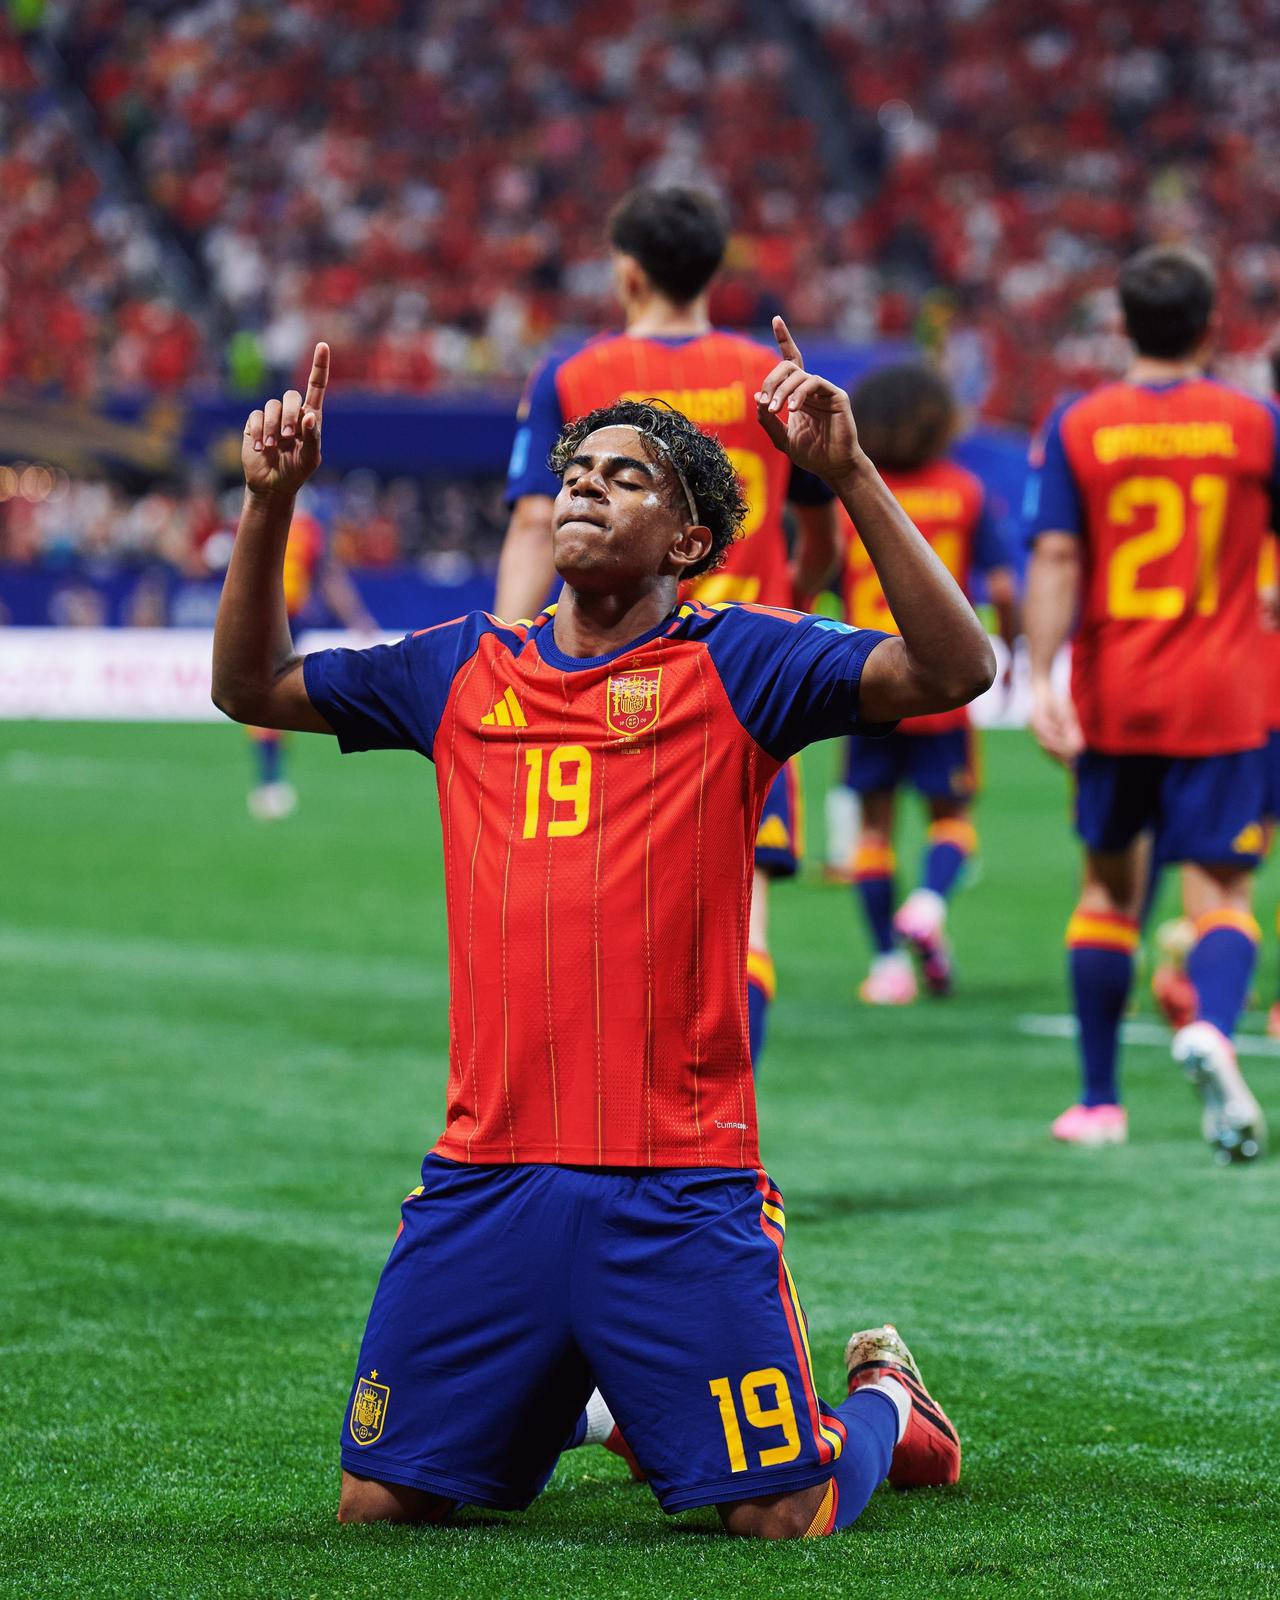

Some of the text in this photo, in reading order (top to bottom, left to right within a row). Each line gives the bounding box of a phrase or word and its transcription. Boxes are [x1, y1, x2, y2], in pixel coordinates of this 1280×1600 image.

[1108, 474, 1227, 620] 21
[522, 745, 592, 839] 19
[708, 1367, 801, 1473] 19
